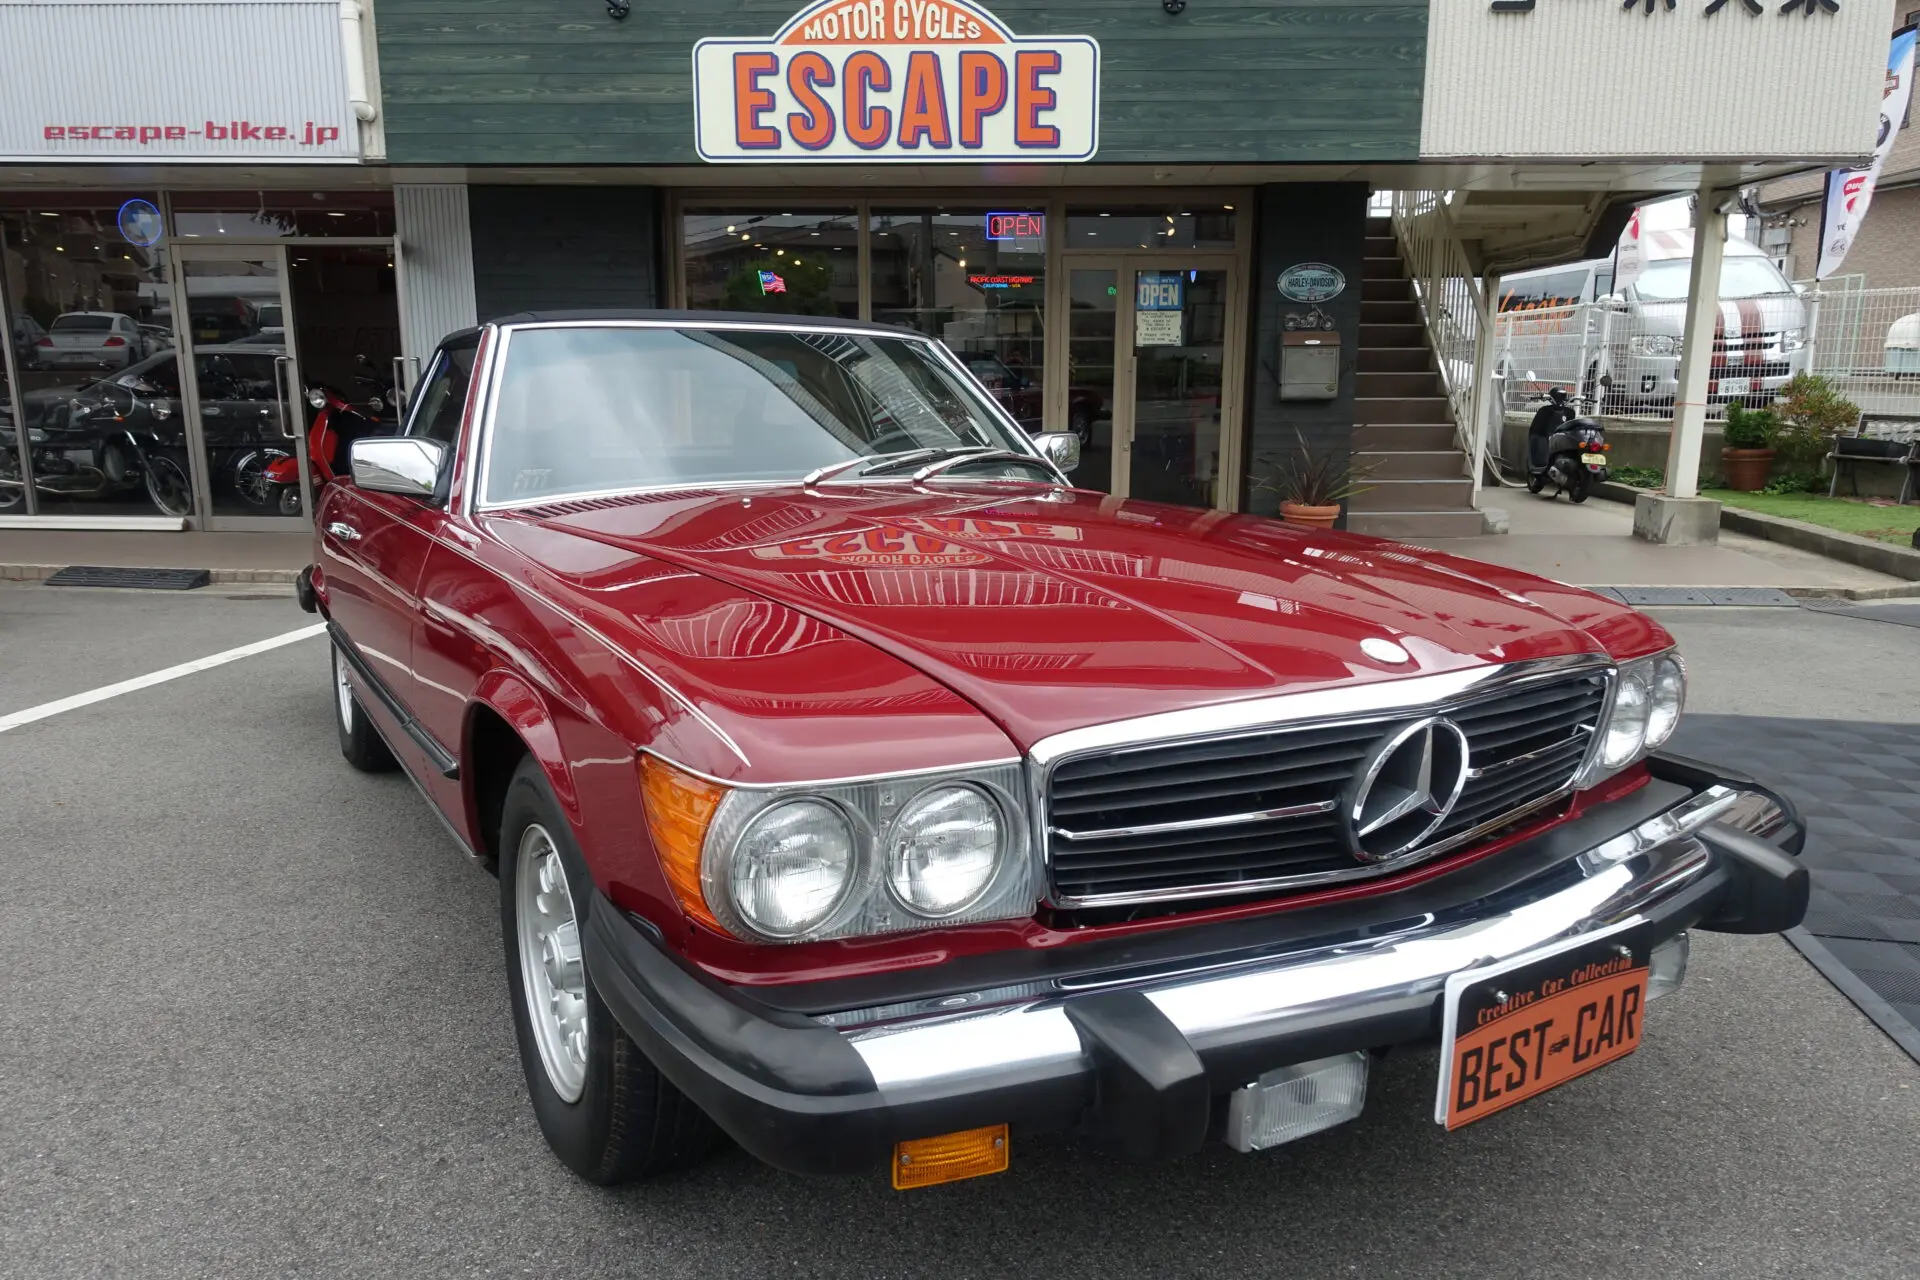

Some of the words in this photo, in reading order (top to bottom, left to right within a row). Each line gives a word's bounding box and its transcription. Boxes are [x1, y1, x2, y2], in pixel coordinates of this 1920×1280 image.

[804, 1, 885, 40] MOTOR
[894, 1, 982, 40] CYCLES
[733, 50, 1062, 150] ESCAPE
[44, 121, 339, 145] escape-bike.jp
[991, 217, 1040, 235] OPEN
[1140, 284, 1178, 306] OPEN
[1287, 277, 1336, 288] HARLEY-DAVIDSON
[1477, 990, 1535, 1026] Creative
[1541, 976, 1564, 997] Car
[1570, 958, 1633, 987] Collection
[1456, 1019, 1553, 1113] BEST
[1572, 984, 1640, 1063] CAR
